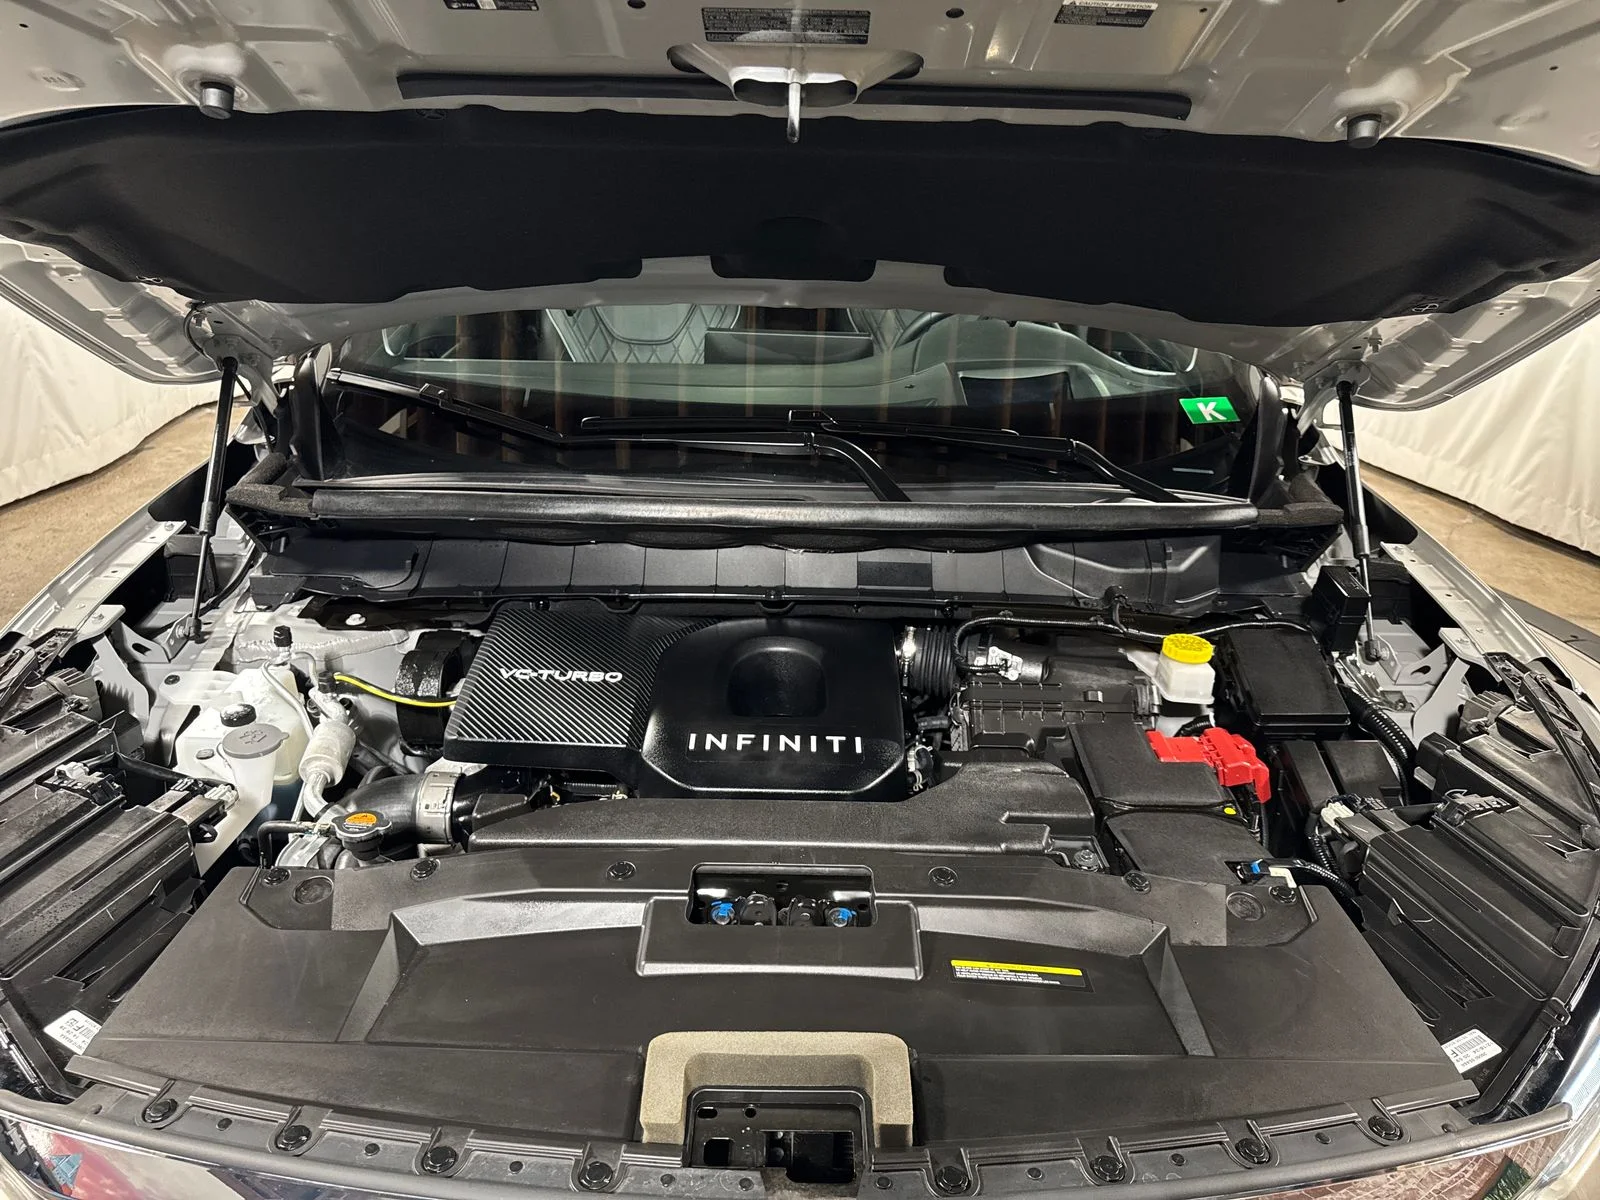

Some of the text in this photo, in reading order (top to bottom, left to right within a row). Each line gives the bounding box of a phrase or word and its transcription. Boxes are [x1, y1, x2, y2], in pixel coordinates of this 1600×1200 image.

[1196, 401, 1227, 421] K
[499, 668, 623, 683] VC-TURBO
[688, 733, 862, 754] INFINITI
